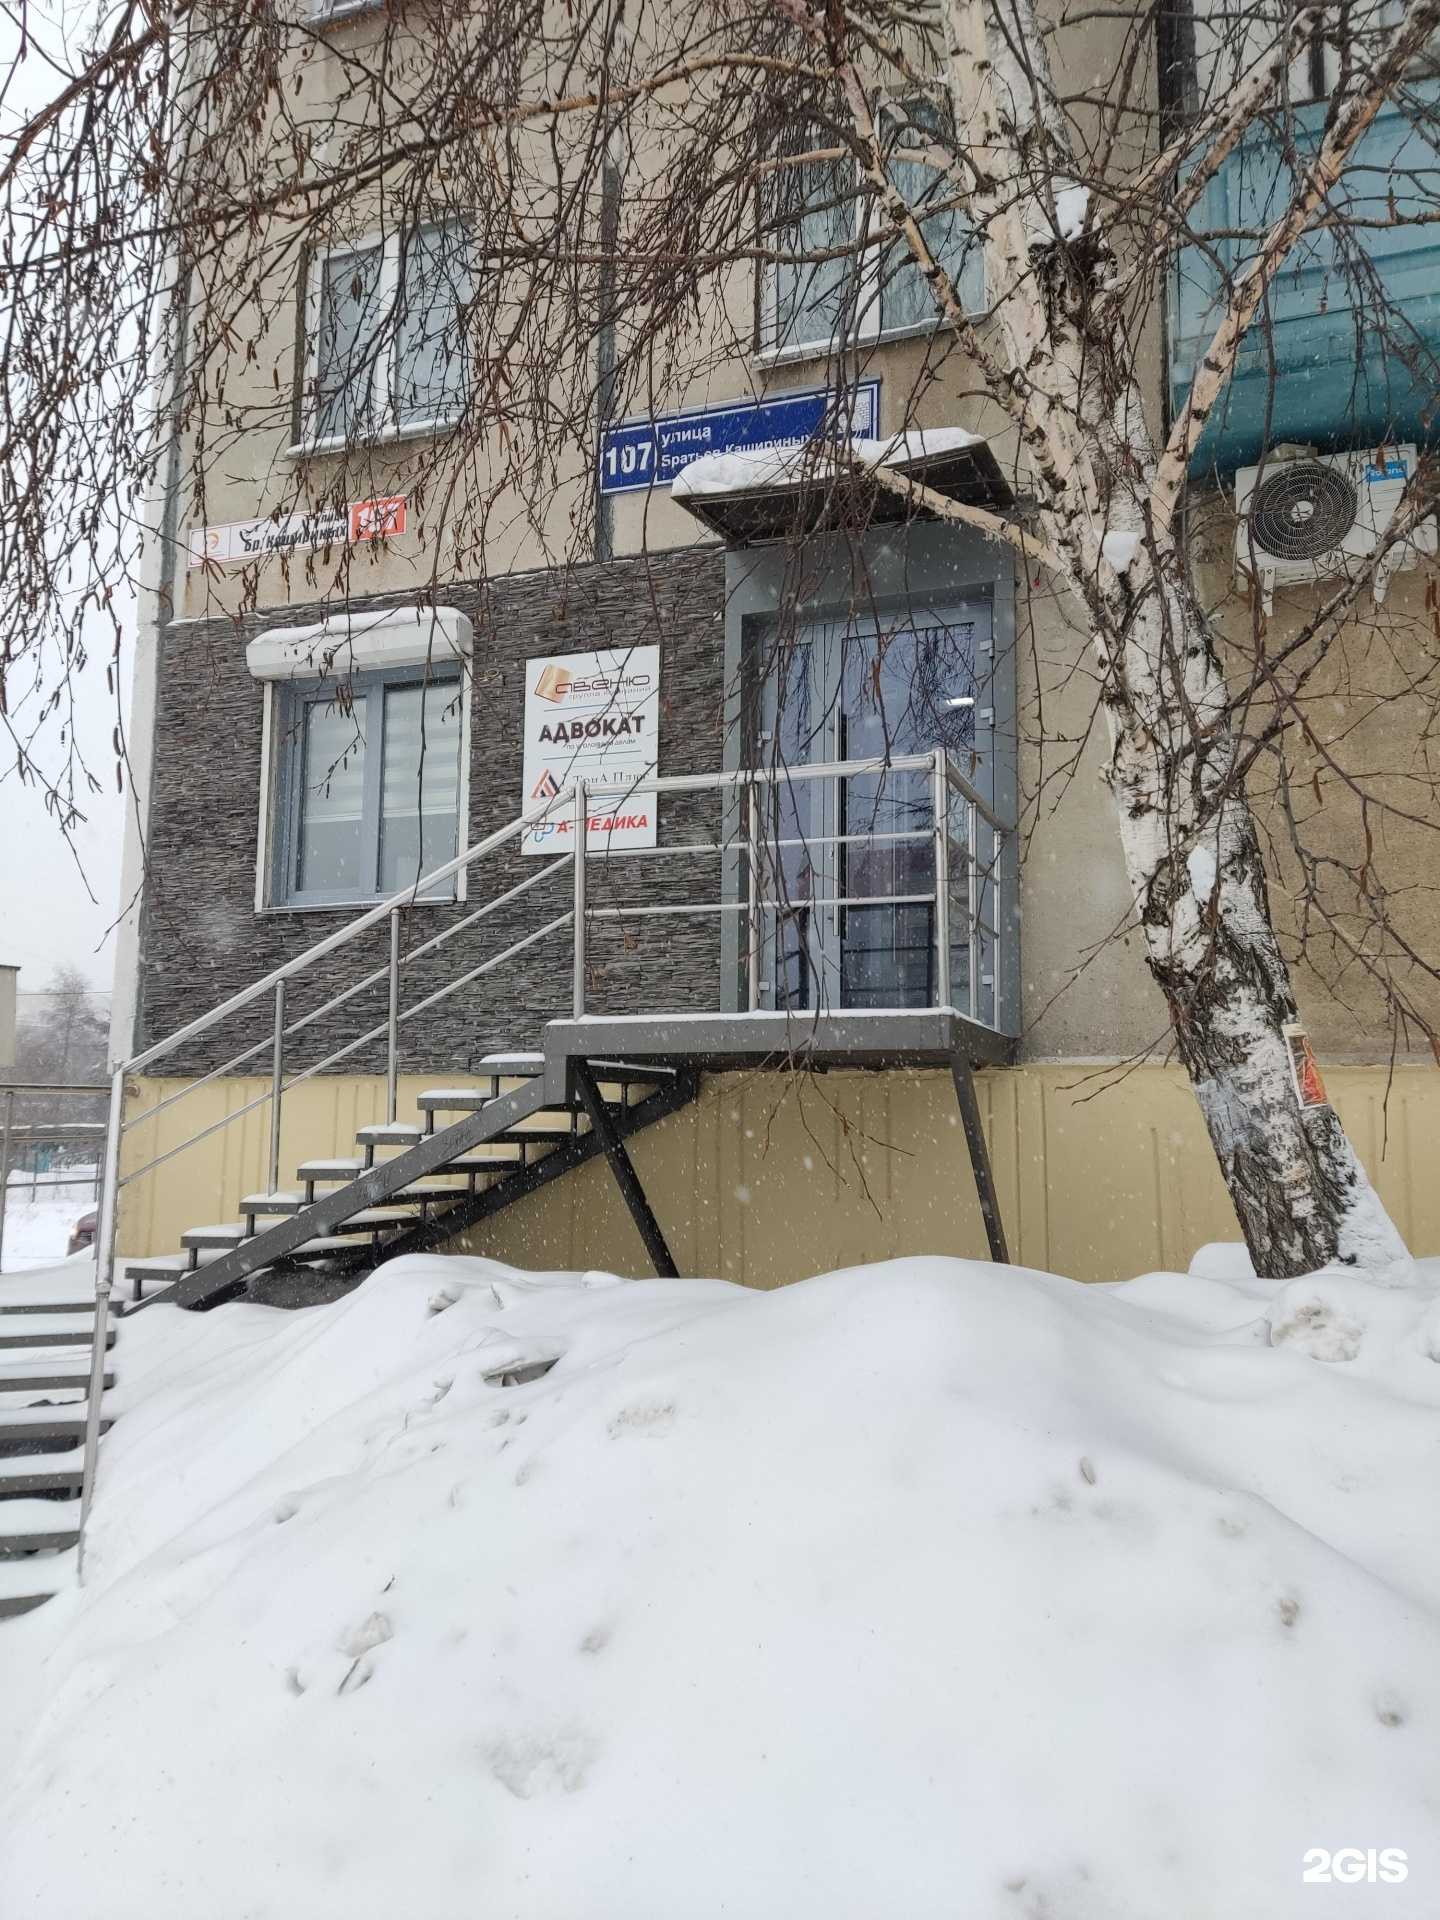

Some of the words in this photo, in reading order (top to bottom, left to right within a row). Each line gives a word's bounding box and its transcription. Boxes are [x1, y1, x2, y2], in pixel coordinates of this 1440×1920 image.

[660, 426, 712, 448] улица
[605, 441, 651, 476] 107
[538, 715, 646, 744] АДВОКАТ
[556, 815, 648, 834] А-ЕДИКА
